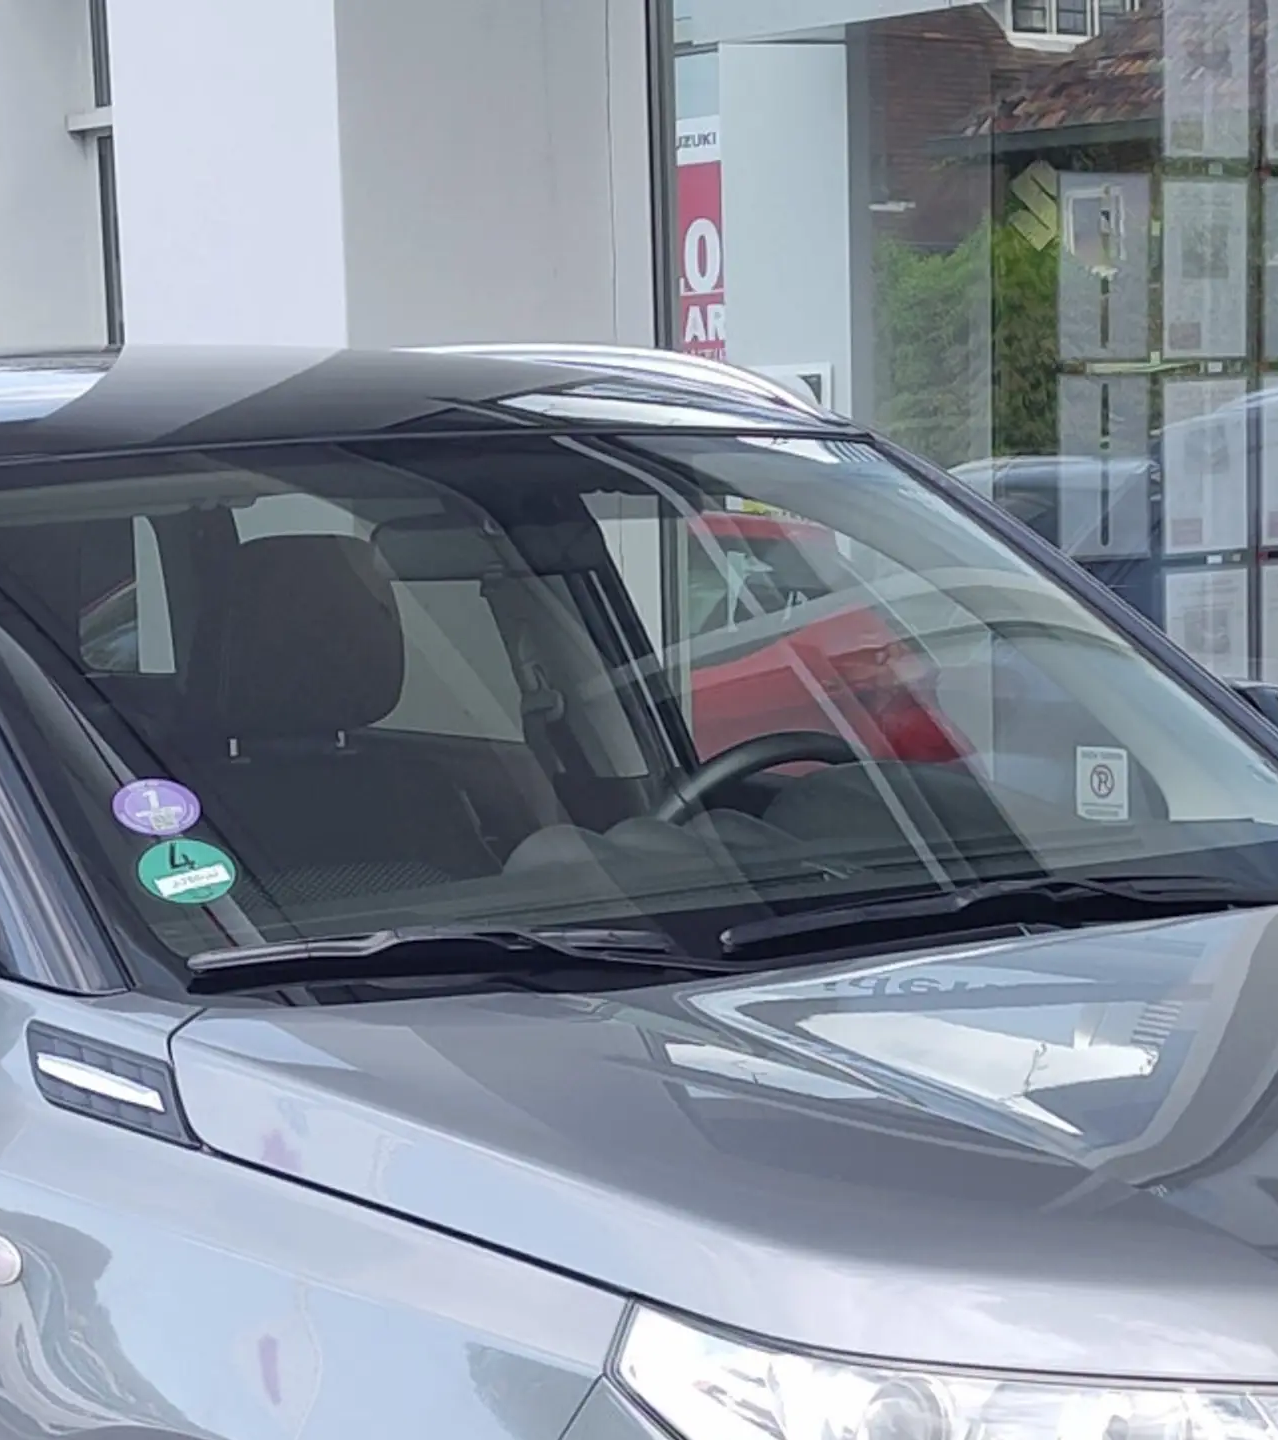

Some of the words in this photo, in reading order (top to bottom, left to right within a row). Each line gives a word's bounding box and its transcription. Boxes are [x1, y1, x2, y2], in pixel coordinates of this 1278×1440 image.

[677, 131, 717, 149] UZUKI
[684, 304, 726, 343] AR
[169, 842, 196, 870] 4
